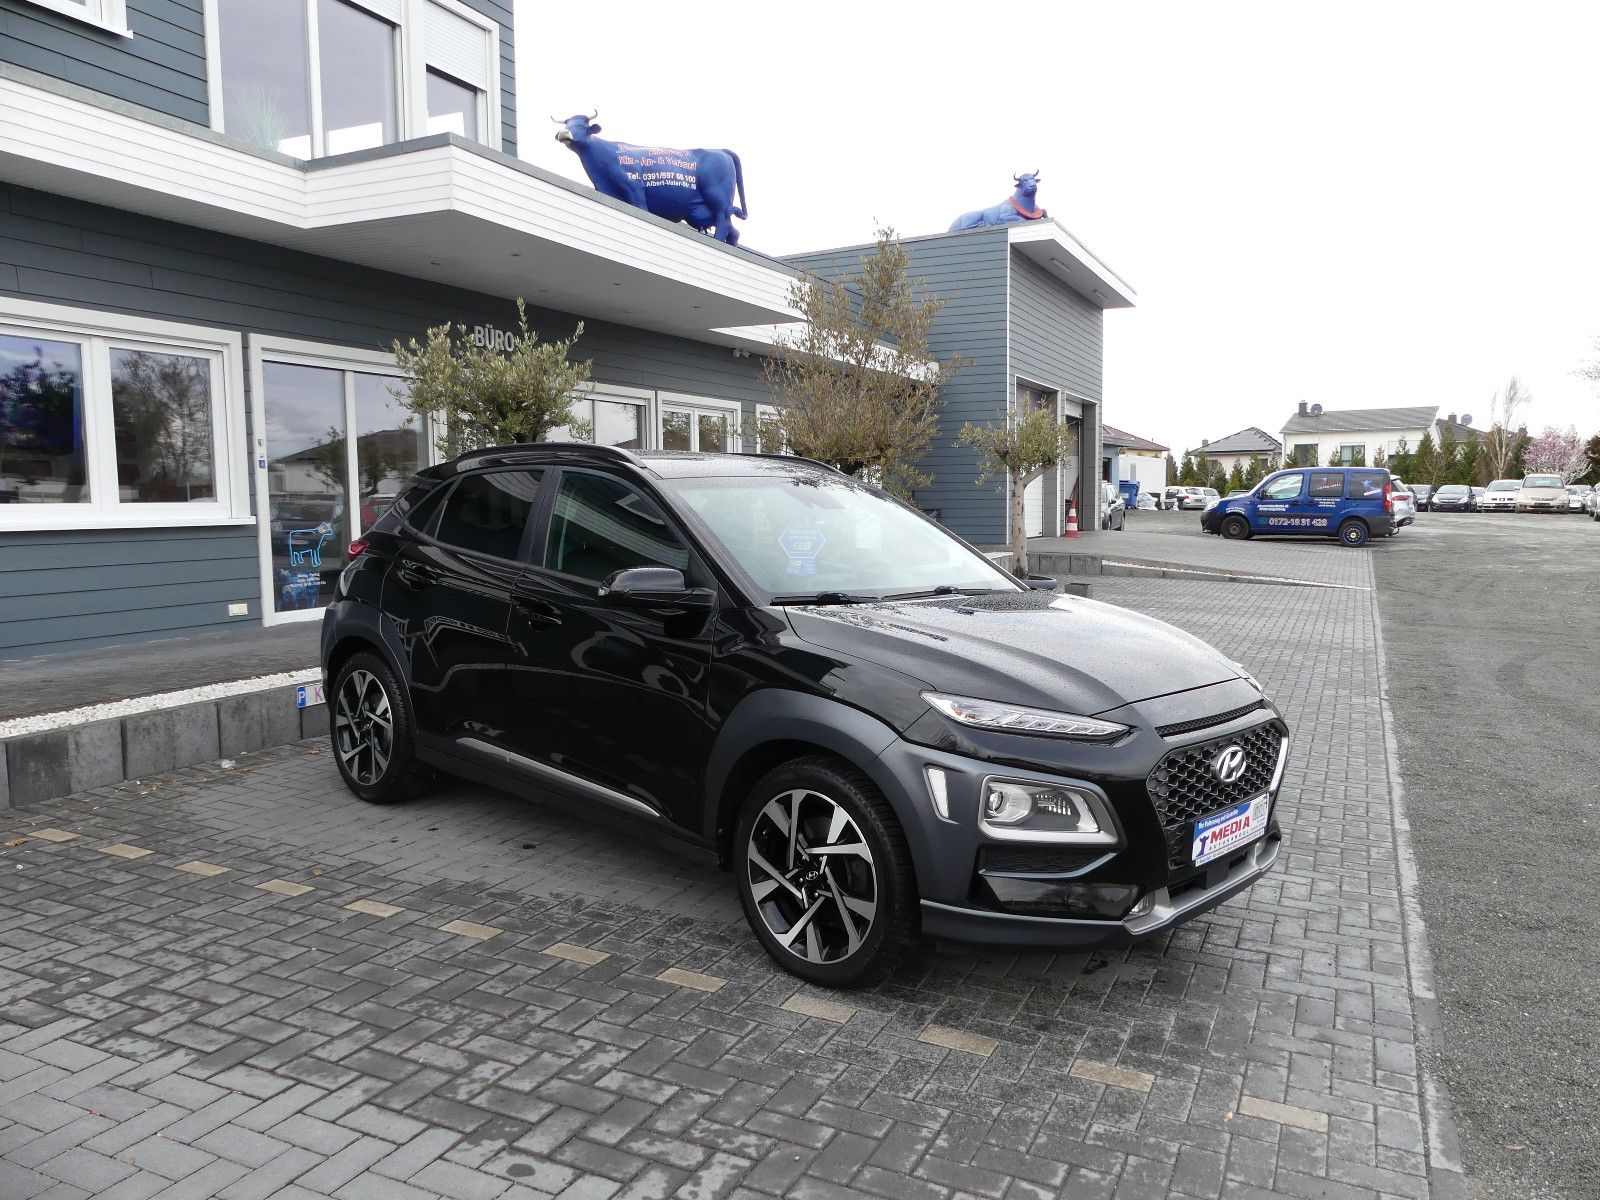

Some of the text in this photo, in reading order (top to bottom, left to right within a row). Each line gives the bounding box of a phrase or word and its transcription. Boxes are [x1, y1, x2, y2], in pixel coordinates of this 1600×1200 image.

[627, 172, 641, 180] Tel.
[642, 172, 674, 181] 0391/597
[474, 323, 515, 352] BÜRO
[1209, 816, 1250, 844] MEDIA
